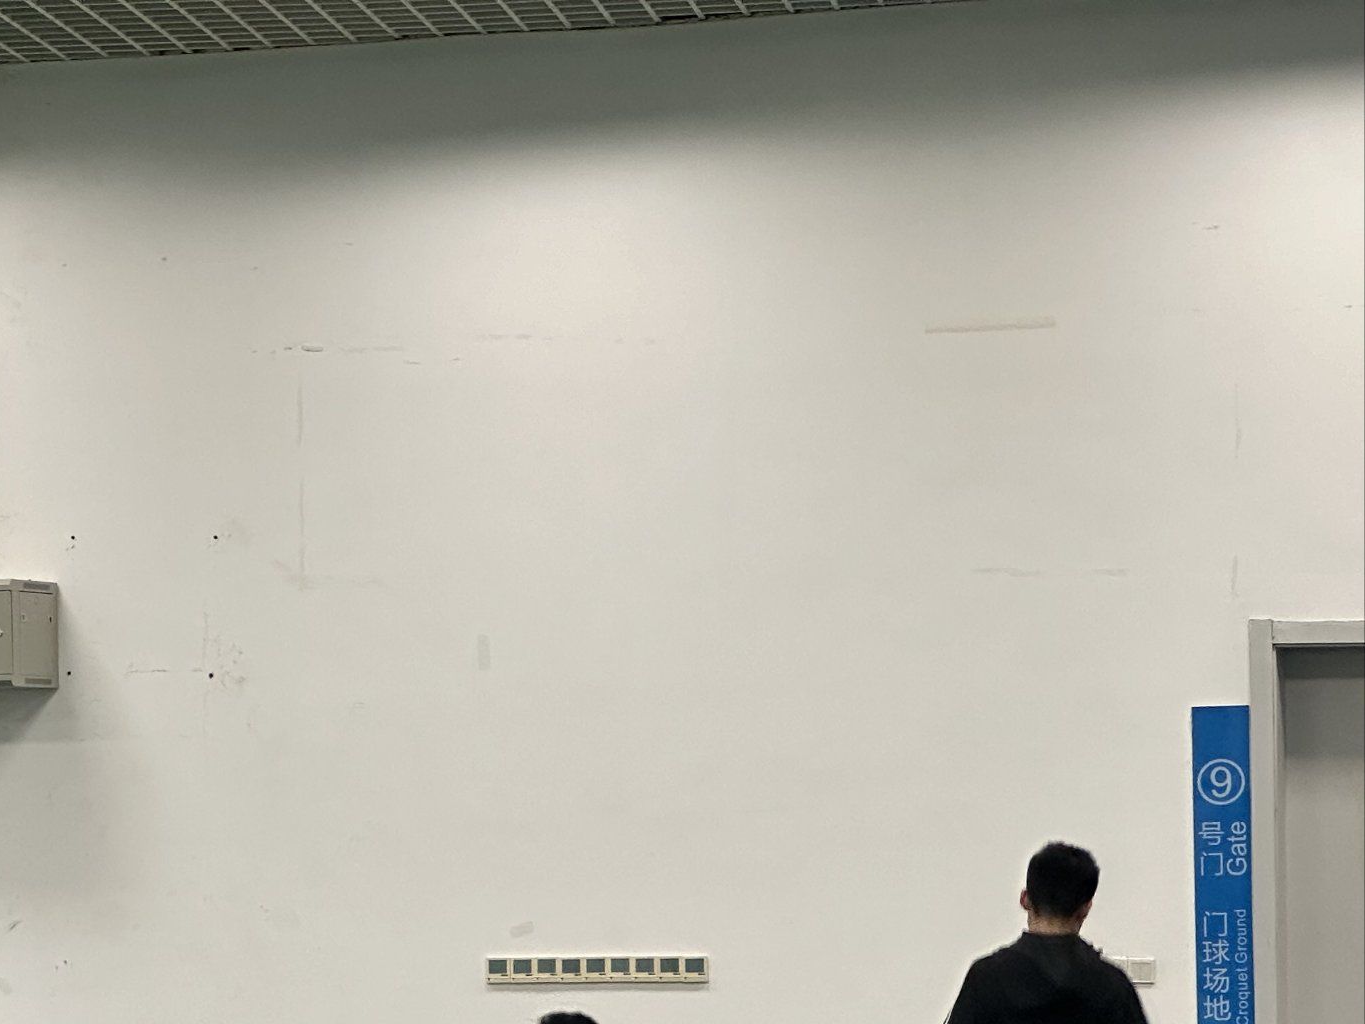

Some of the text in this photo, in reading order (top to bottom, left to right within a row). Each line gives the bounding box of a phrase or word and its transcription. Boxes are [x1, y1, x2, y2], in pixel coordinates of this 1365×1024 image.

[1198, 821, 1225, 876] 号门
[1226, 821, 1248, 876] Gate
[1234, 909, 1248, 964] Ground
[1202, 911, 1231, 1021] 门球场地
